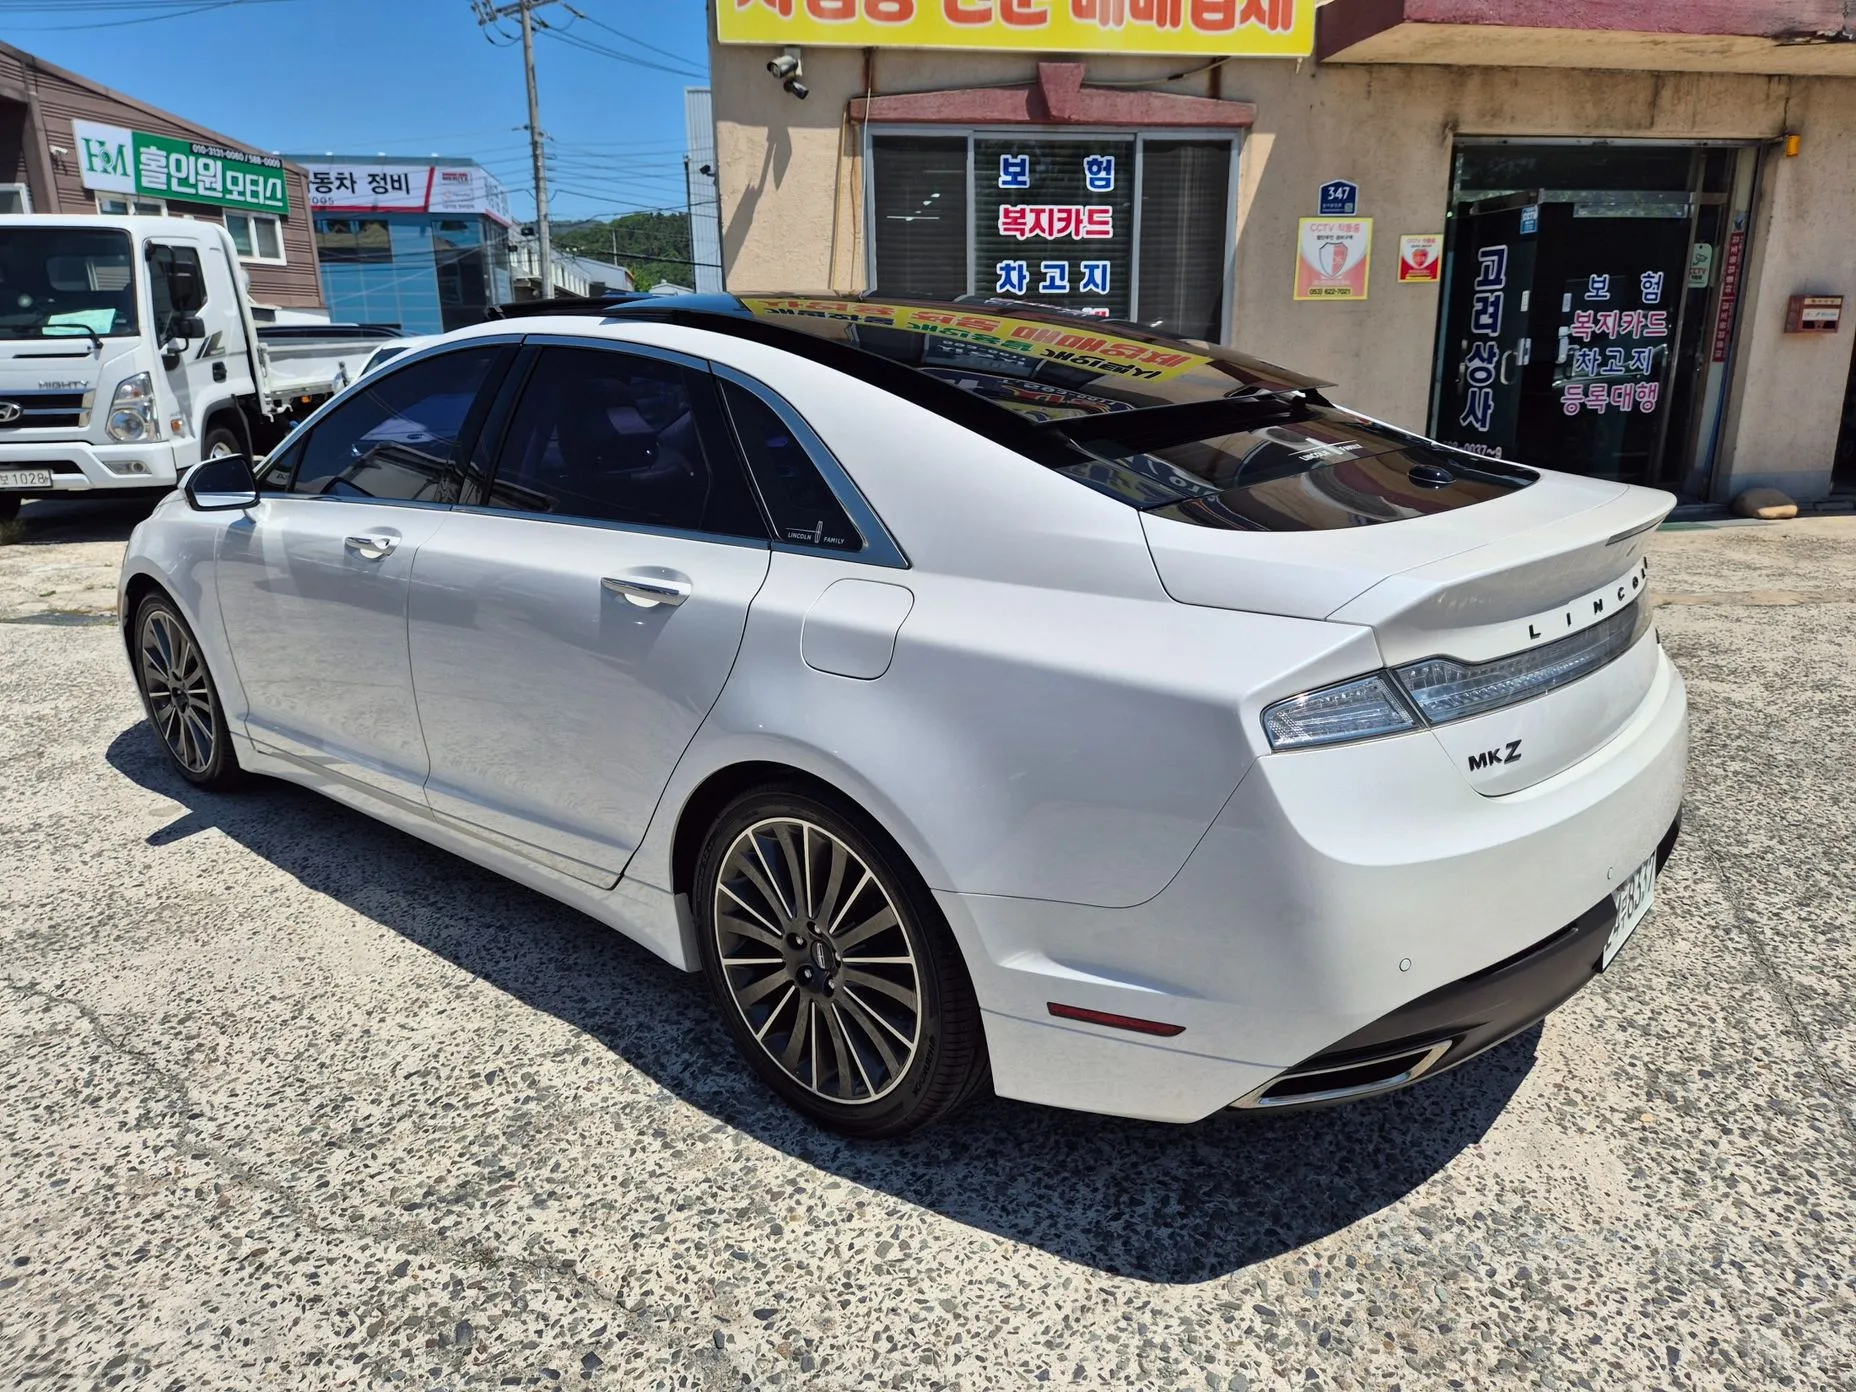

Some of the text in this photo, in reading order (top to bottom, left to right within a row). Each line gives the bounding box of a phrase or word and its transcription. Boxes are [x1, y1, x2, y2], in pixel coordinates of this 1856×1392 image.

[139, 146, 284, 207] 홀인원 모터스
[367, 172, 411, 195] 정비
[1327, 186, 1351, 200] 347
[998, 205, 1113, 240] 복지카드
[1309, 223, 1335, 233] CCTV
[1460, 244, 1508, 432] 고려상사
[1571, 310, 1669, 341] 복지카드
[1575, 347, 1654, 377] 차고지
[1561, 382, 1660, 415] 등록대행
[788, 532, 844, 545] LINCOLN FAMILY
[1468, 739, 1522, 772] MKZ
